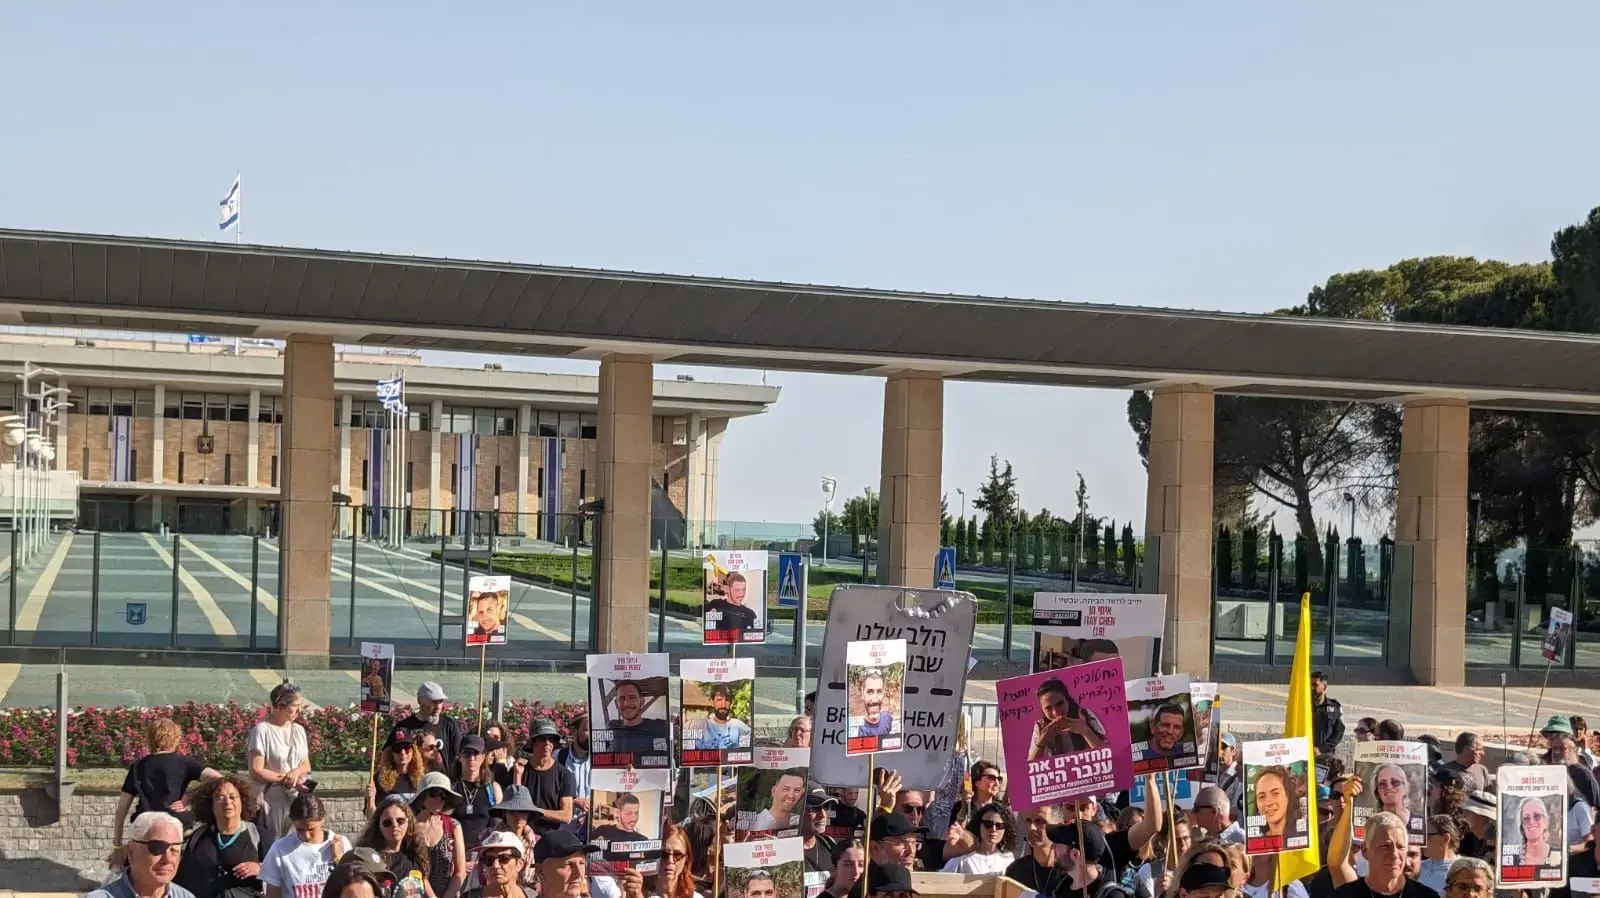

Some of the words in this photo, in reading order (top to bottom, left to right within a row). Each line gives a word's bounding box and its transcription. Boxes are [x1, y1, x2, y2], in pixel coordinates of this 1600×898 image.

[1097, 605, 1112, 616] איתי
[1084, 616, 1096, 626] ITAY
[1098, 616, 1116, 626] CHEN
[906, 624, 947, 648] הלב
[907, 655, 944, 673] שבו
[904, 710, 945, 728] HEM
[592, 730, 614, 742] BRING
[682, 728, 703, 740] BRING
[592, 741, 606, 753] HIM
[903, 734, 948, 751] OW!
[1054, 747, 1112, 768] מחזירים
[1028, 759, 1051, 774] את
[1071, 759, 1113, 780] ענבר
[1029, 768, 1067, 795] הימן
[1354, 807, 1374, 817] BRING
[1247, 815, 1266, 826] BRING
